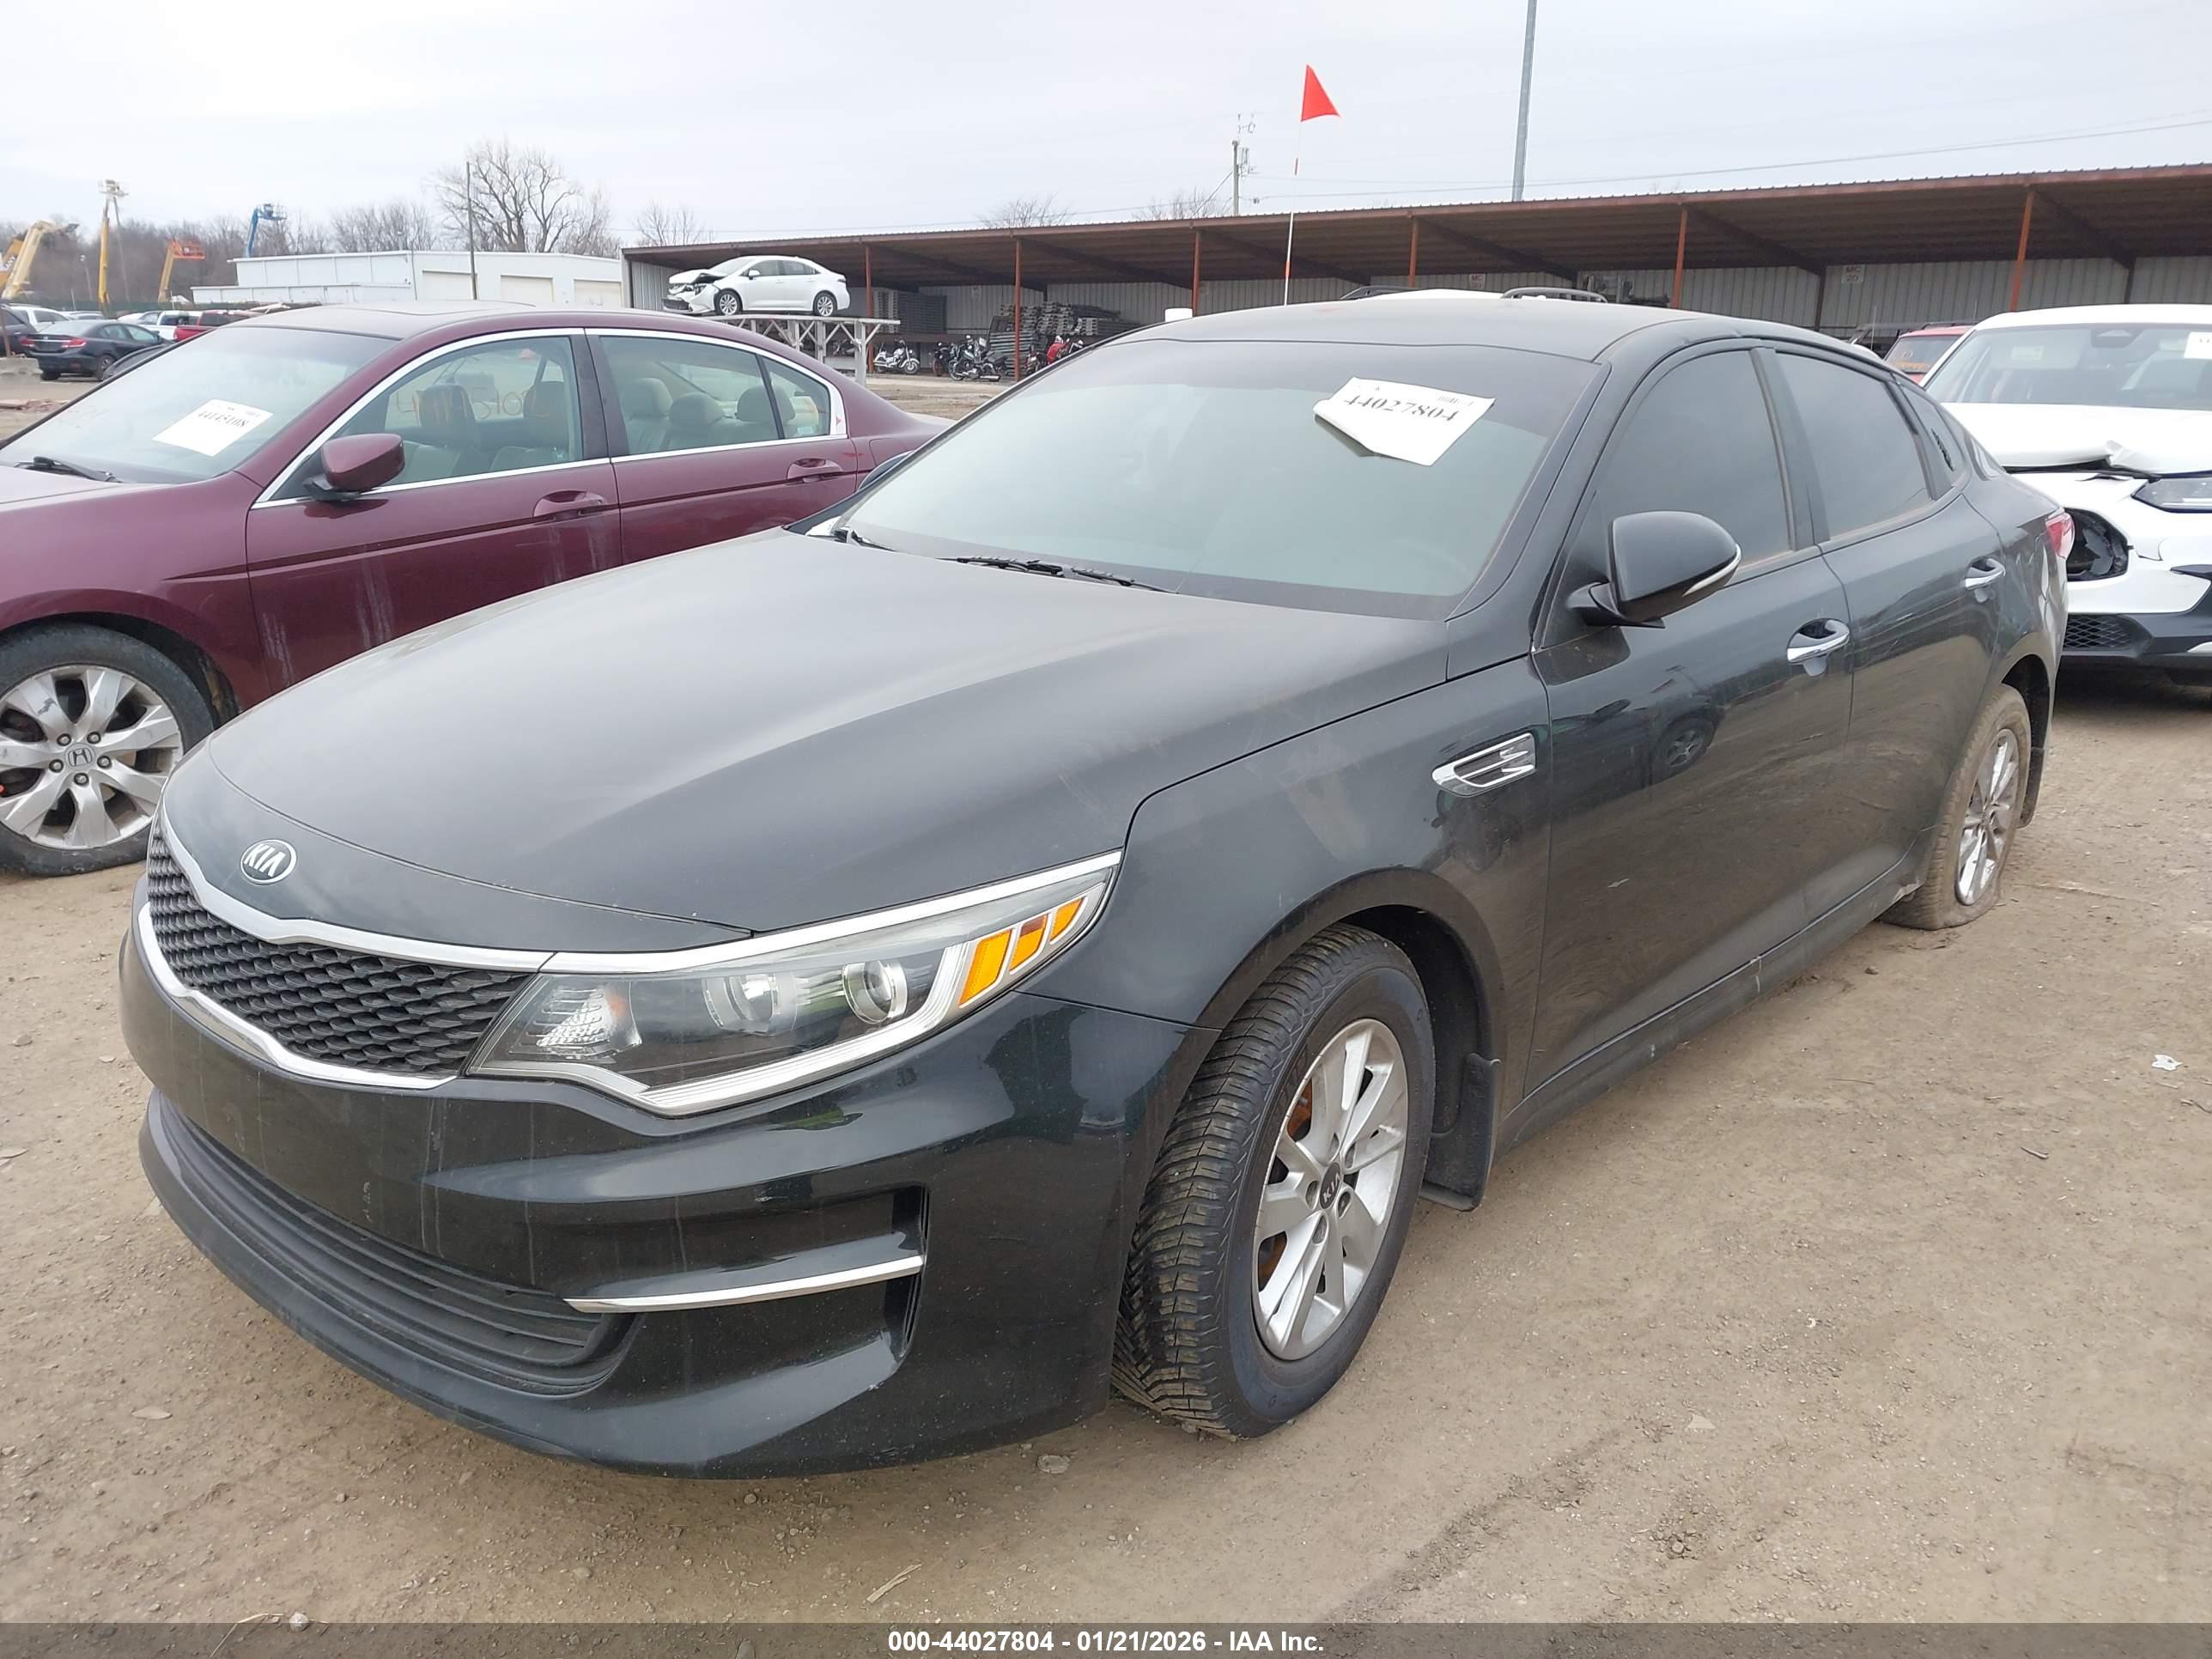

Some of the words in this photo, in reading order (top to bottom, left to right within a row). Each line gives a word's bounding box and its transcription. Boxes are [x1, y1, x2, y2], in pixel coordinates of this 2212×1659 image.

[1344, 394, 1460, 422] 44027804
[243, 842, 287, 878] KIA
[1322, 1172, 1340, 1204] KIA
